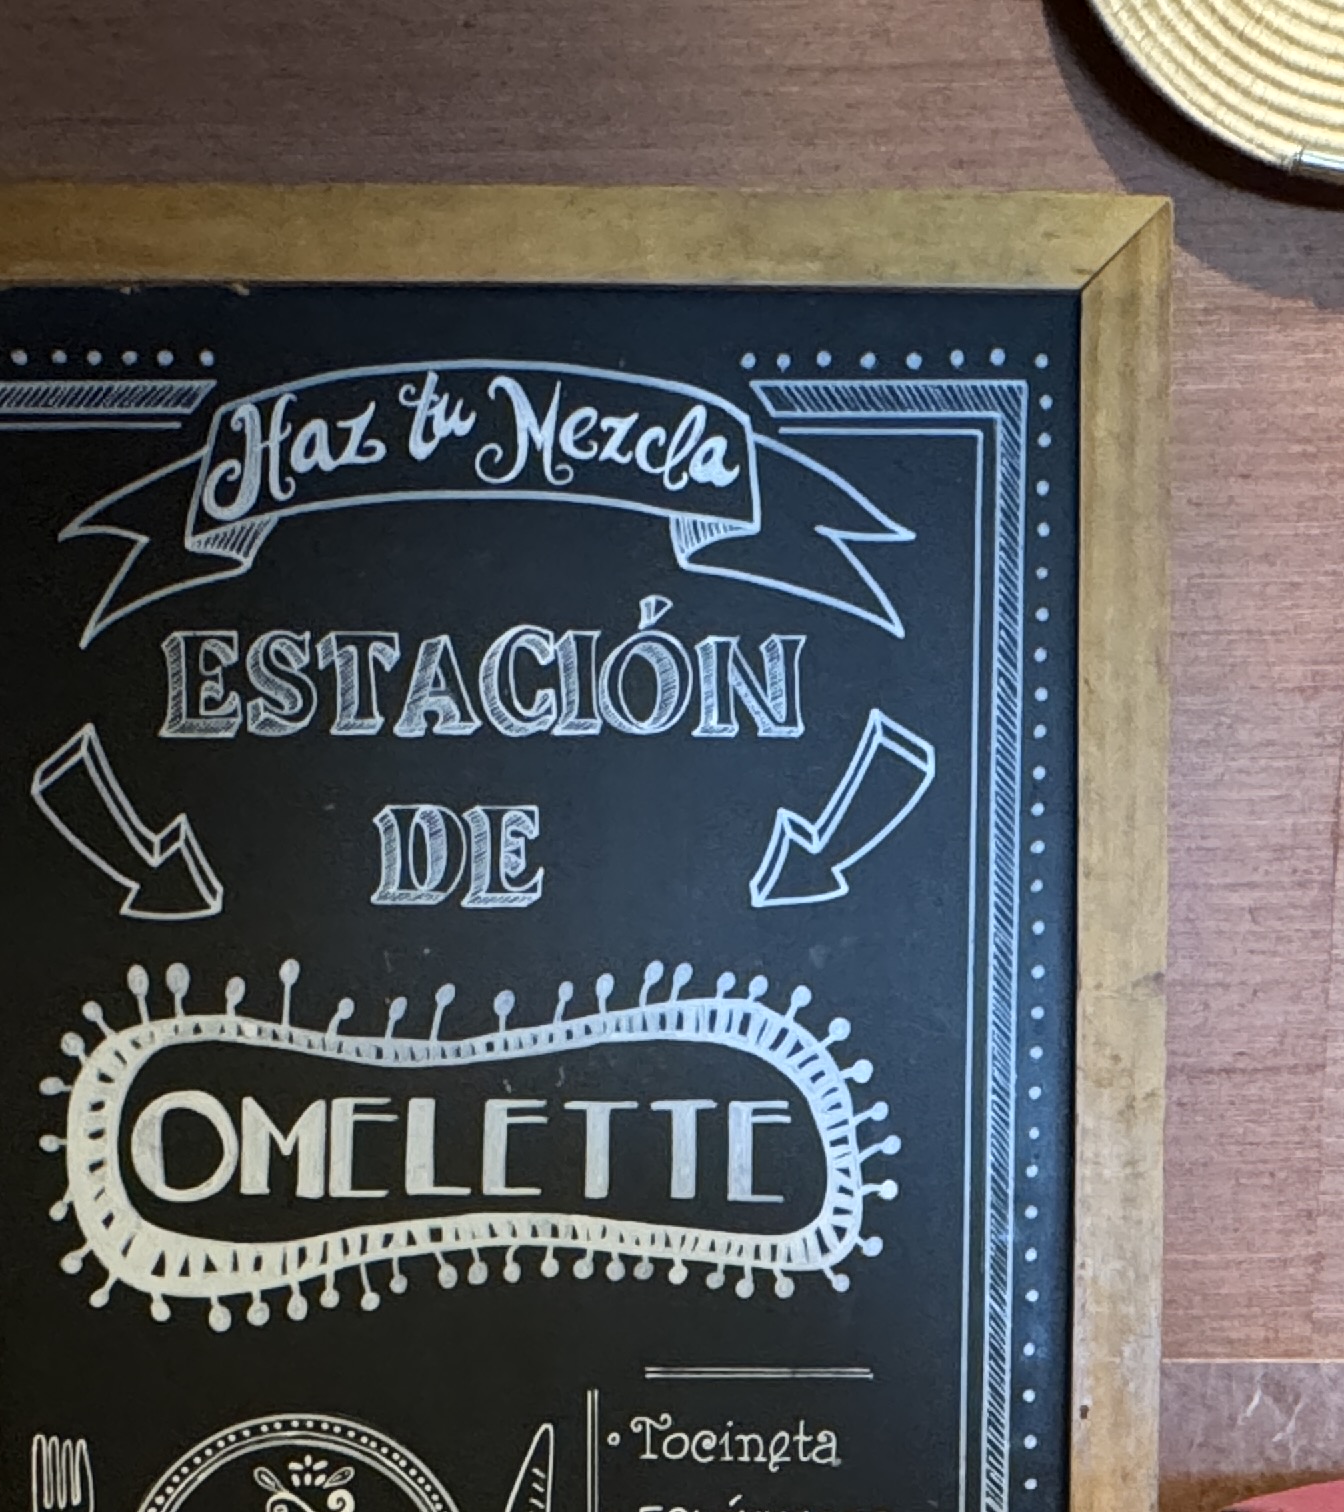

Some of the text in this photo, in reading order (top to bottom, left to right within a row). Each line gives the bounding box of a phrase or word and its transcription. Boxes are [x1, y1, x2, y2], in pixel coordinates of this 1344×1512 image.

[201, 370, 742, 522] Haz tu Mezcla
[158, 594, 808, 740] ESTACIÓN
[371, 803, 545, 909] DE
[130, 1089, 793, 1204] OMELETTE
[629, 1412, 842, 1473] Tocineta
